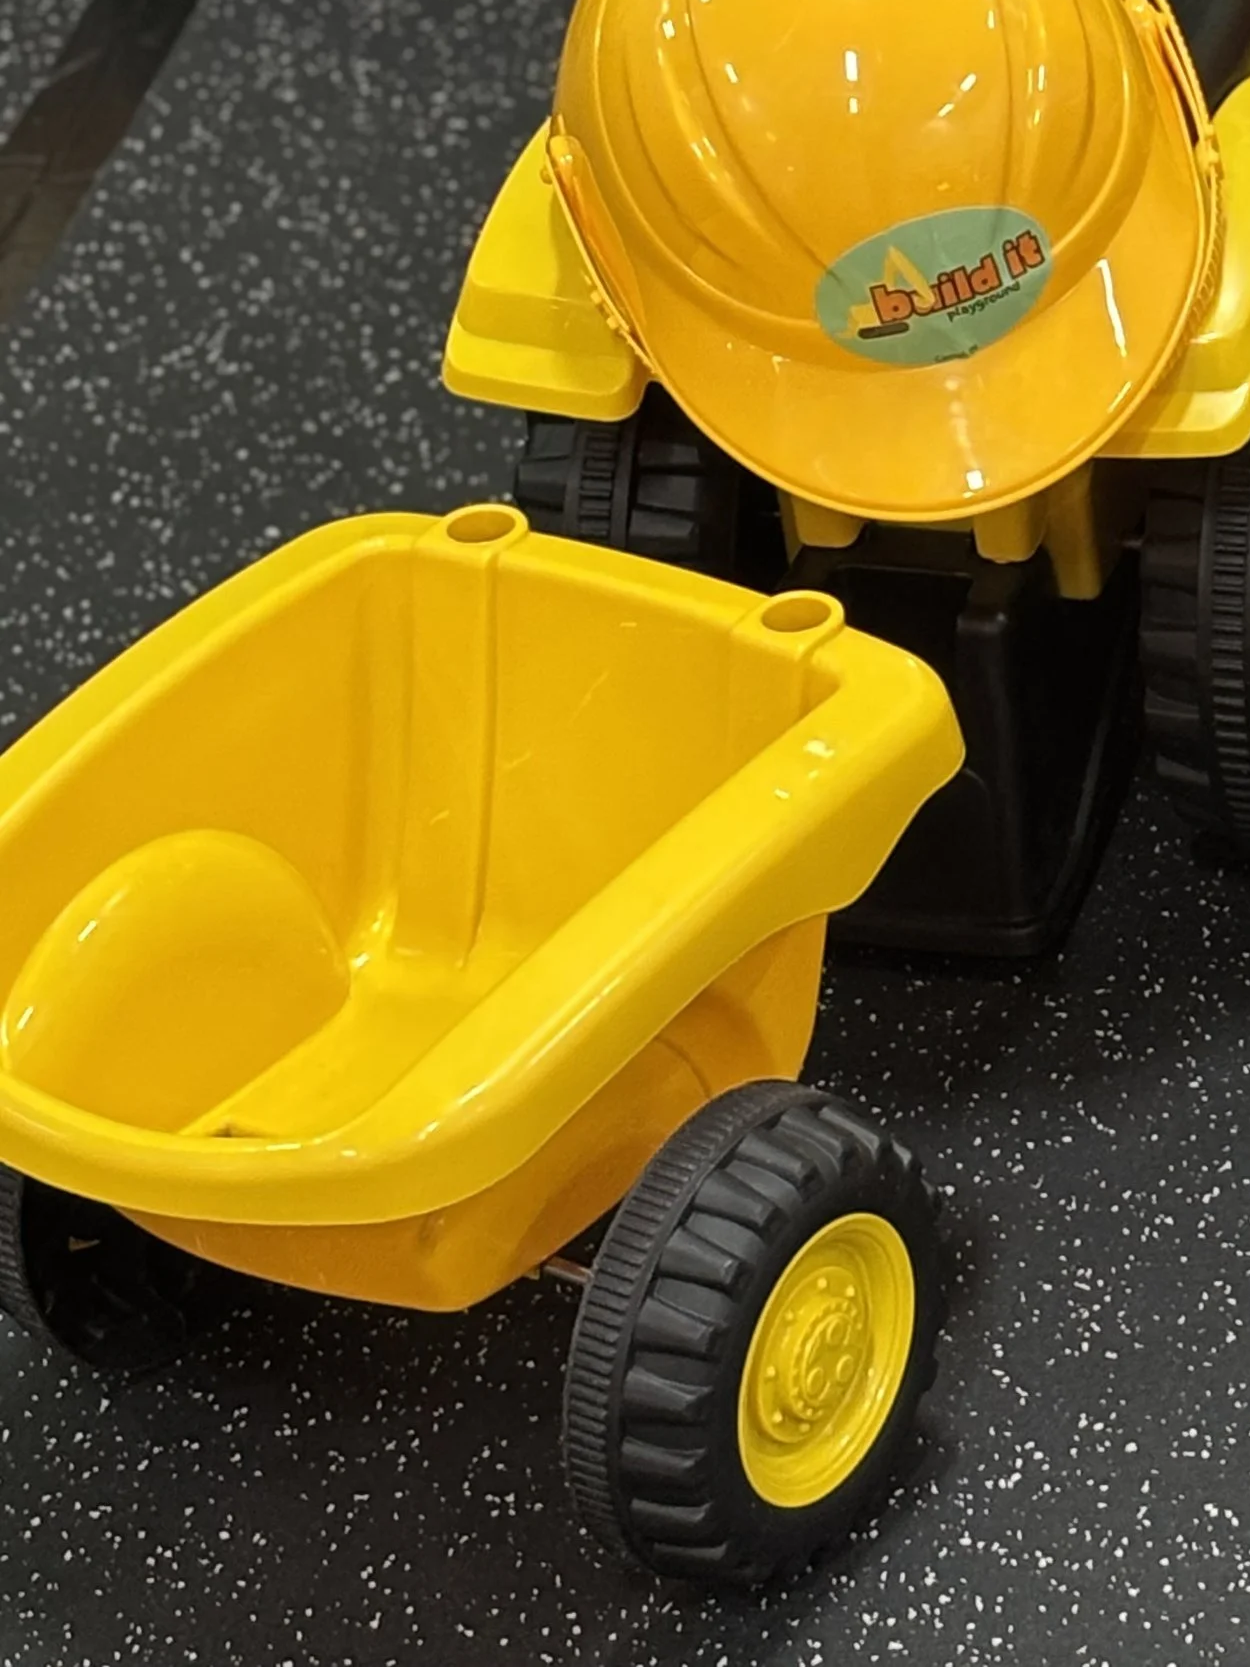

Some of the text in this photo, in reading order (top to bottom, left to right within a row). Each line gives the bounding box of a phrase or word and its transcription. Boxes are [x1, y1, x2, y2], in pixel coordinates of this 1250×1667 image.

[869, 229, 1046, 324] build it
[946, 281, 1021, 322] playground
